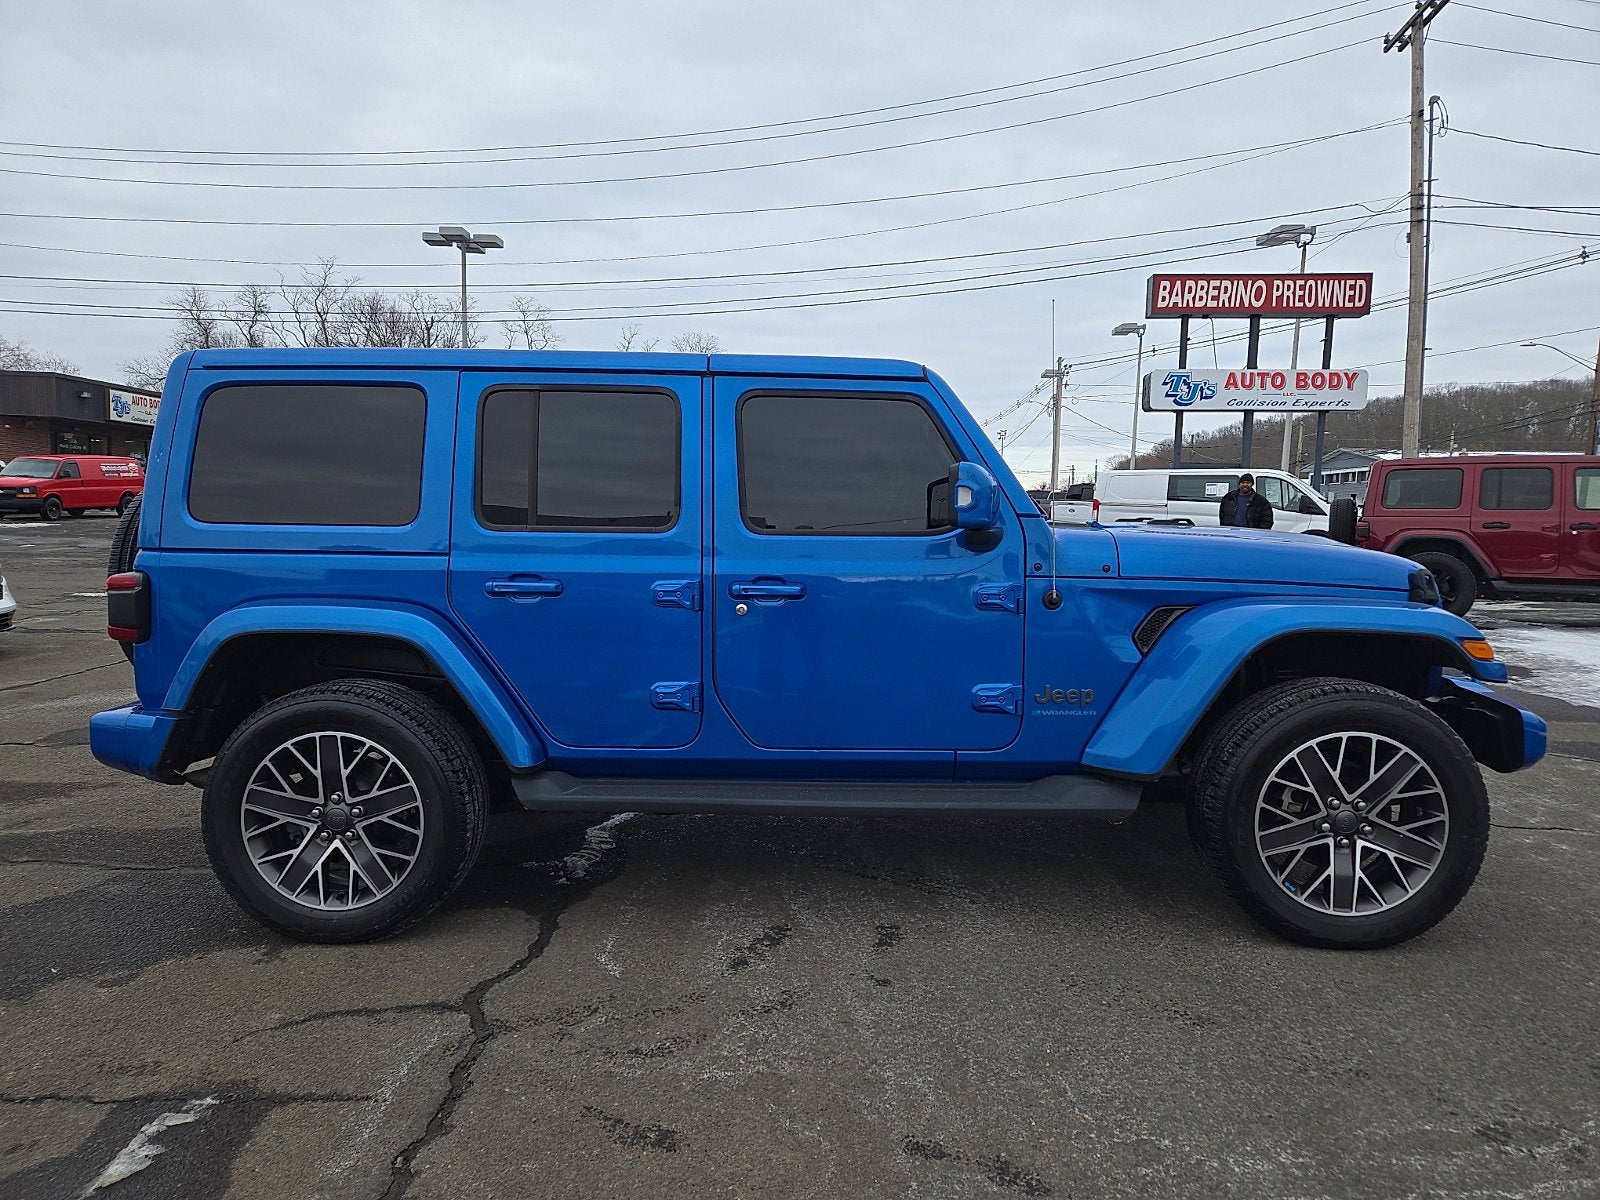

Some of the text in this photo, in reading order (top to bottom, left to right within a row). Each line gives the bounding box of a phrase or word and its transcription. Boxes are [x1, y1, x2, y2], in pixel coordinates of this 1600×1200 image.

[1157, 279, 1367, 308] BARBERINO PREOWNED
[1161, 371, 1218, 407] TJ's
[1224, 371, 1360, 391] AUTO BODY
[131, 395, 148, 407] AUTO
[1226, 398, 1352, 409] Collision Experts
[1034, 684, 1095, 708] Jeep
